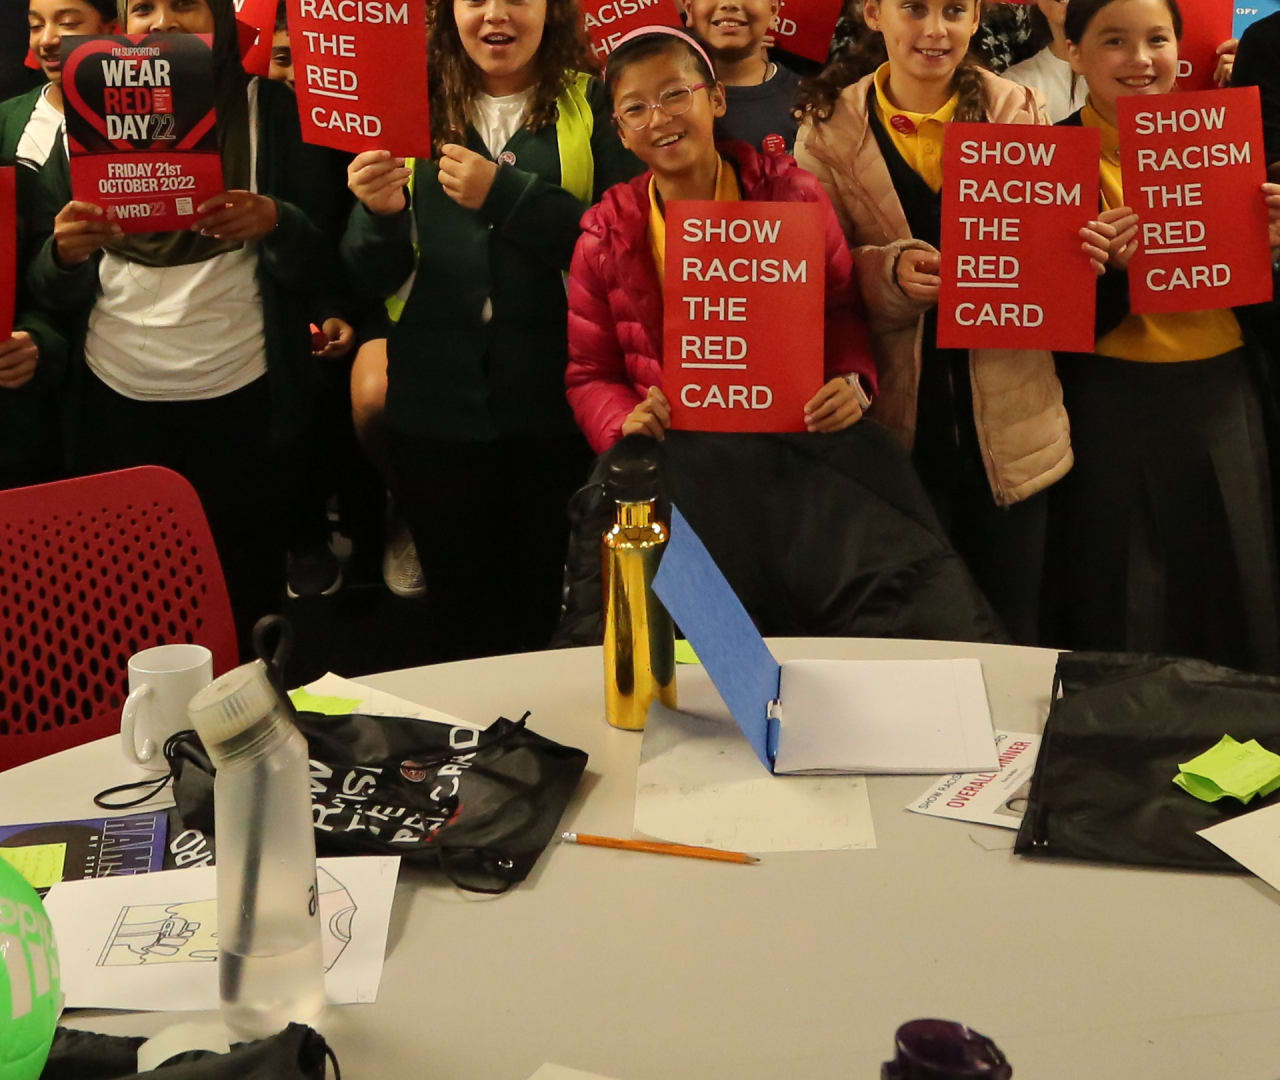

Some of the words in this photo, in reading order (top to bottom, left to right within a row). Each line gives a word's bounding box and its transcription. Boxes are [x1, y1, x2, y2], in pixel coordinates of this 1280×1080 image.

[121, 47, 159, 56] SUPPORTING
[303, 31, 355, 57] THE
[102, 60, 170, 86] WEAR
[307, 65, 357, 91] RED
[104, 87, 151, 114] RED
[312, 107, 381, 136] CARD
[1135, 107, 1225, 134] SHOW
[960, 141, 1056, 166] SHOW
[1138, 142, 1250, 171] RACISM
[108, 163, 152, 177] FRIDAY
[99, 178, 158, 193] OCTOBER
[160, 176, 195, 190] 2022
[960, 180, 1080, 205] RACISM
[1141, 184, 1202, 208] THE
[683, 219, 781, 243] SHOW
[959, 218, 1020, 241] THE
[1143, 221, 1205, 244] RED
[683, 258, 806, 282] RACISM
[958, 256, 1019, 278] RED
[1147, 264, 1230, 290] CARD
[683, 297, 746, 320] THE
[955, 303, 1043, 327] CARD
[682, 336, 747, 359] RED
[681, 384, 772, 408] CARD
[947, 773, 997, 808] OVERALL
